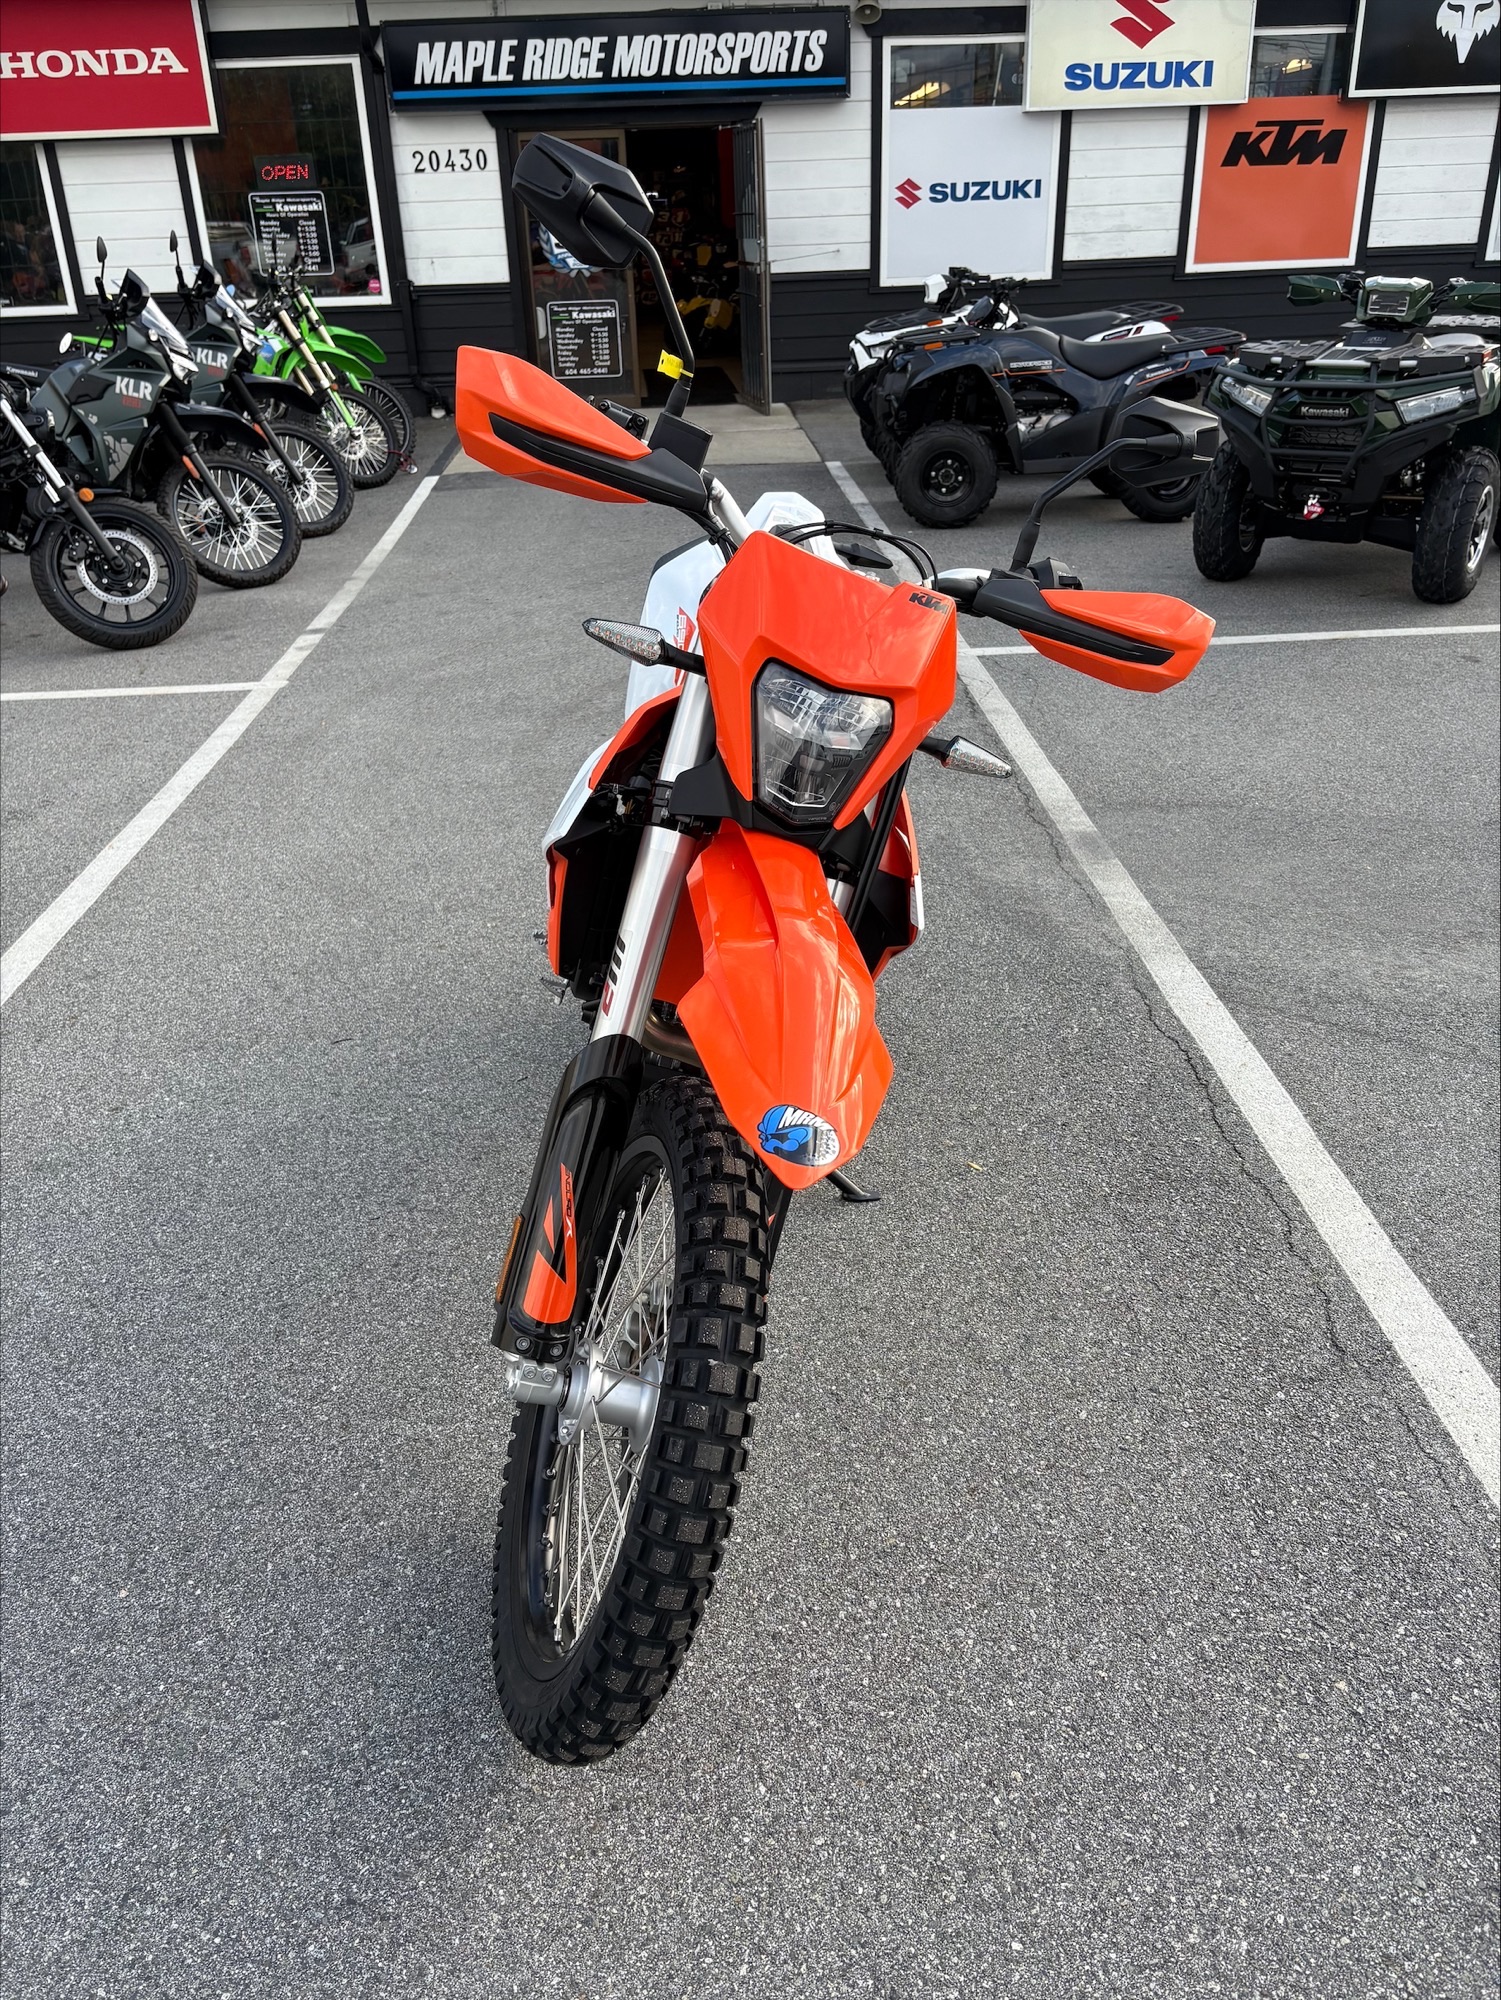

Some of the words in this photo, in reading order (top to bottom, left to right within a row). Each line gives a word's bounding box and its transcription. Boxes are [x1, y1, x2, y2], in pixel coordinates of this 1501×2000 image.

[0, 47, 189, 79] HONDA
[413, 38, 520, 85] MAPLE
[521, 36, 609, 81] RIDGE
[611, 29, 829, 77] MOTORSPORTS
[1064, 60, 1215, 92] SUZUKI
[1220, 119, 1349, 168] KTM
[261, 164, 309, 181] OPEN
[412, 148, 488, 173] 20430
[928, 178, 1043, 203] SUZUKI
[275, 202, 323, 213] Kawasaki
[286, 211, 310, 219] Operation
[571, 310, 616, 319] Kawasaki
[196, 347, 228, 369] KLR
[5, 366, 39, 378] Kawasaki
[114, 375, 153, 401] KLR
[1300, 406, 1350, 417] Kawasaki
[908, 591, 949, 615] KTM
